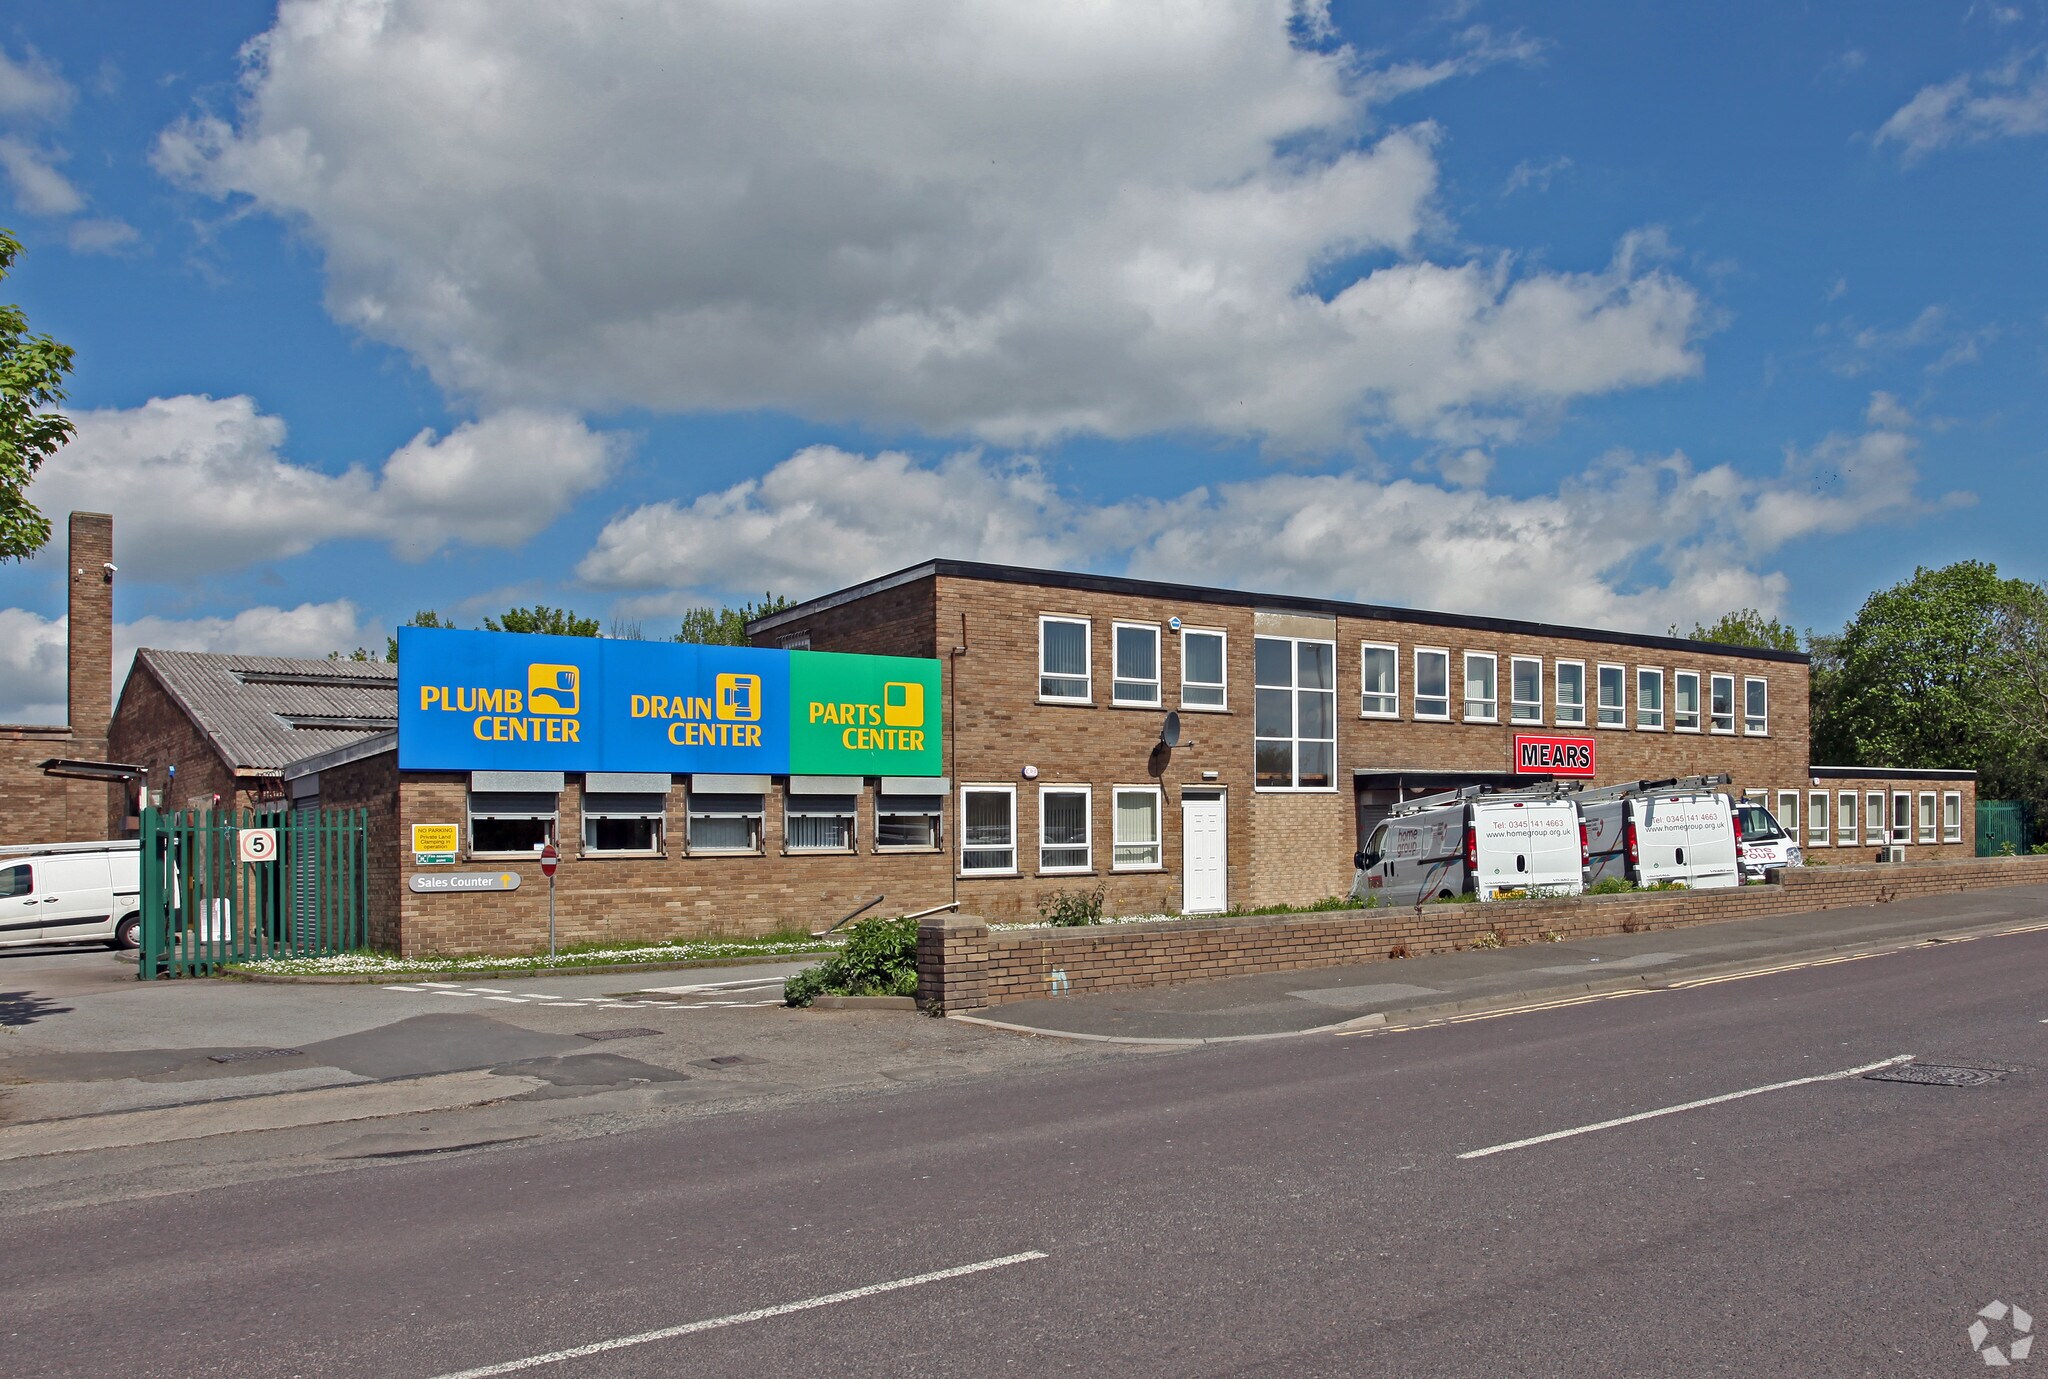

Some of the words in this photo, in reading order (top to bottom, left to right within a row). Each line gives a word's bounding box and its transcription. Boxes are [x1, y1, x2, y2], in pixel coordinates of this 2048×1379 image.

[420, 685, 524, 714] PLUMB
[630, 694, 713, 720] DRAIN
[809, 701, 882, 726] PARTS
[472, 715, 581, 743] CENTER
[667, 722, 763, 747] CENTER
[842, 728, 925, 751] CENTER
[1521, 743, 1591, 769] MEARS
[1492, 821, 1507, 830] Tel:
[1508, 820, 1528, 829] 0345
[1530, 820, 1544, 828] 141
[1545, 819, 1564, 828] 4663
[1651, 815, 1665, 824] Tel:
[1666, 814, 1685, 823] 0345
[1686, 814, 1699, 822] 141
[1700, 812, 1718, 821] 4663
[1485, 828, 1571, 839] www.homegroup.org.uk
[1645, 821, 1725, 833] www.homegroup.org.uk
[1398, 829, 1418, 842] home
[253, 837, 265, 853] 5
[1397, 842, 1418, 858] group
[1743, 852, 1776, 860] roup
[417, 877, 448, 888] Sales
[450, 877, 493, 888] Counter
